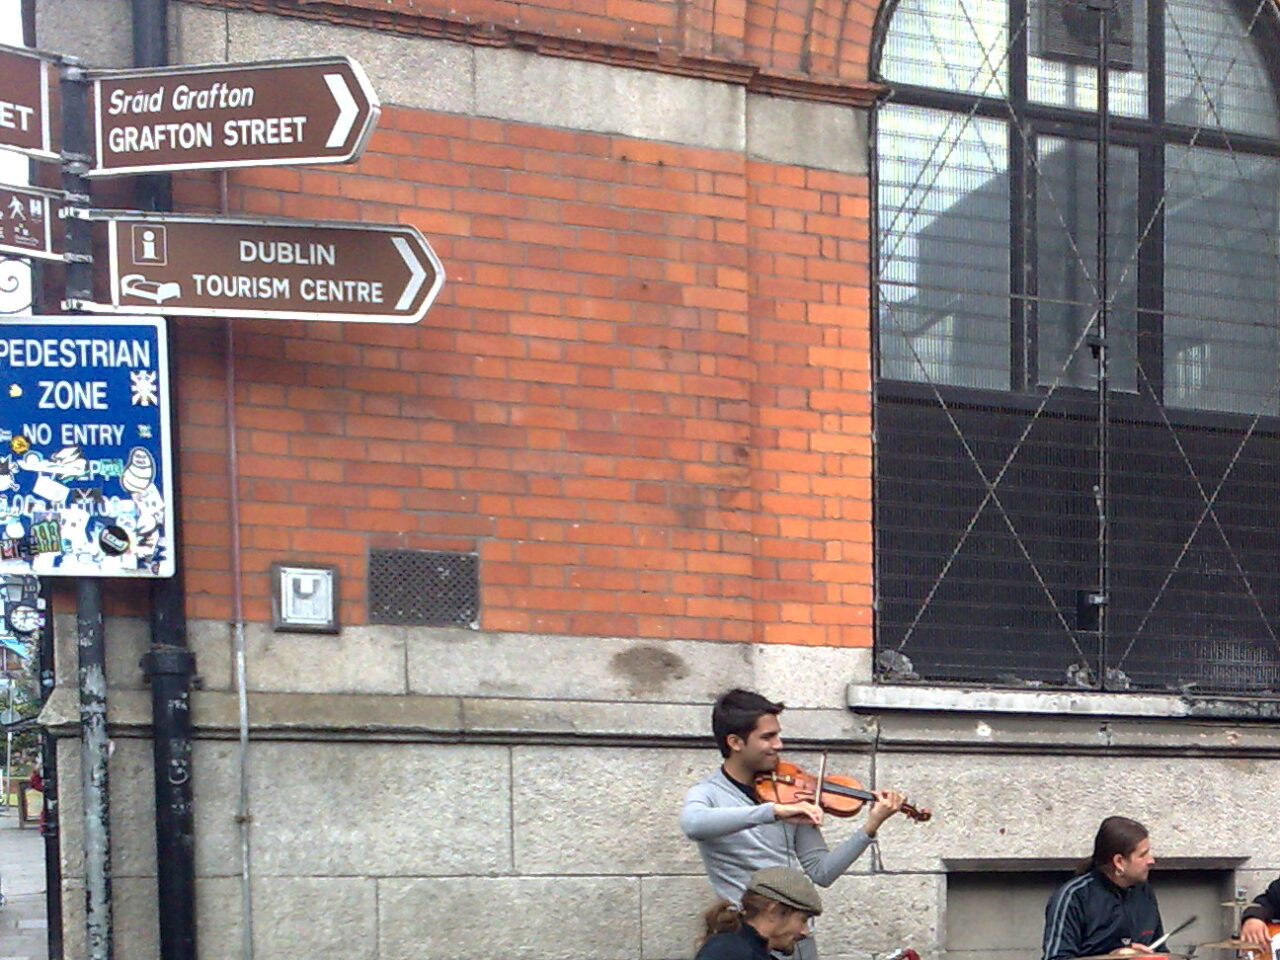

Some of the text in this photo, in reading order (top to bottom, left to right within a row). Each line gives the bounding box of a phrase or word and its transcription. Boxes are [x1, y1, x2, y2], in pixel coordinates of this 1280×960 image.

[172, 82, 254, 111] Grafton
[108, 116, 307, 153] GRAFTON STREET
[239, 240, 336, 265] DUBLIN
[193, 273, 384, 303] TOURISM CENTRE
[0, 338, 149, 367] PEDESTRIAN
[38, 380, 109, 409] ZONE
[23, 422, 125, 446] NO ENTRY
